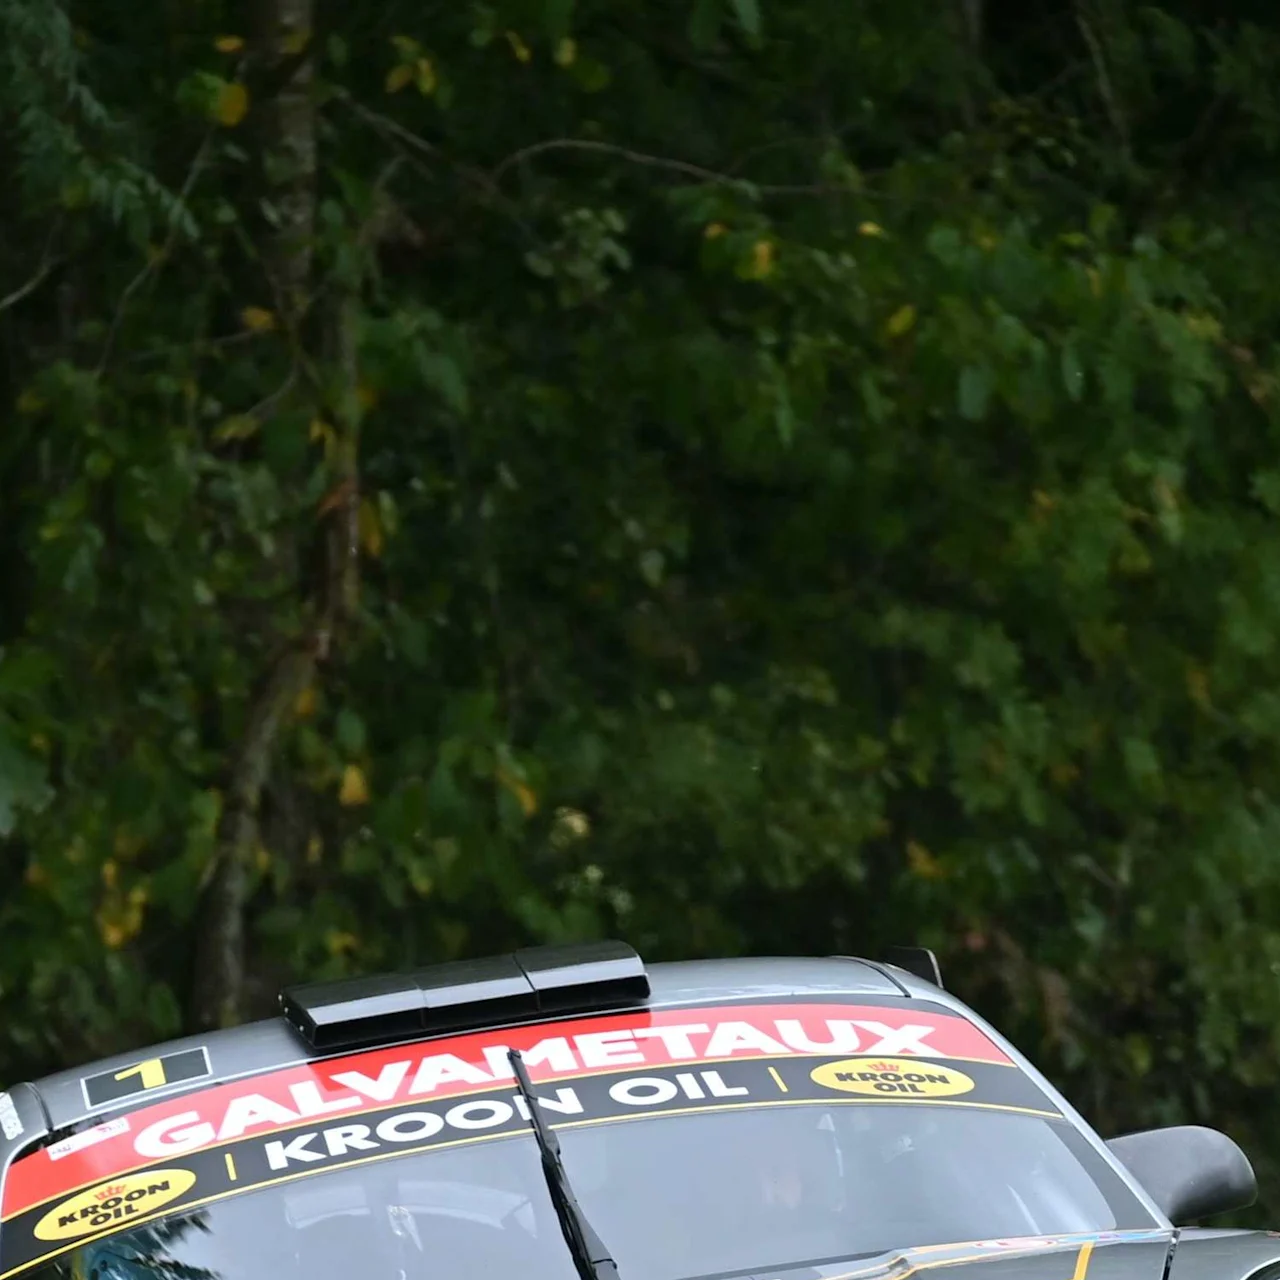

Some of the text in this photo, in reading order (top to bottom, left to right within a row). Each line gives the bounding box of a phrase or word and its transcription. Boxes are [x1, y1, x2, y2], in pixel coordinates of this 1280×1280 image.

[114, 1058, 167, 1089] 1
[134, 1019, 948, 1158] GALVAMETAUX
[835, 1072, 951, 1085] KROON
[873, 1082, 926, 1094] OIL
[265, 1070, 749, 1170] KROON OIL
[57, 1180, 171, 1228] KROON
[89, 1204, 140, 1226] OIL
